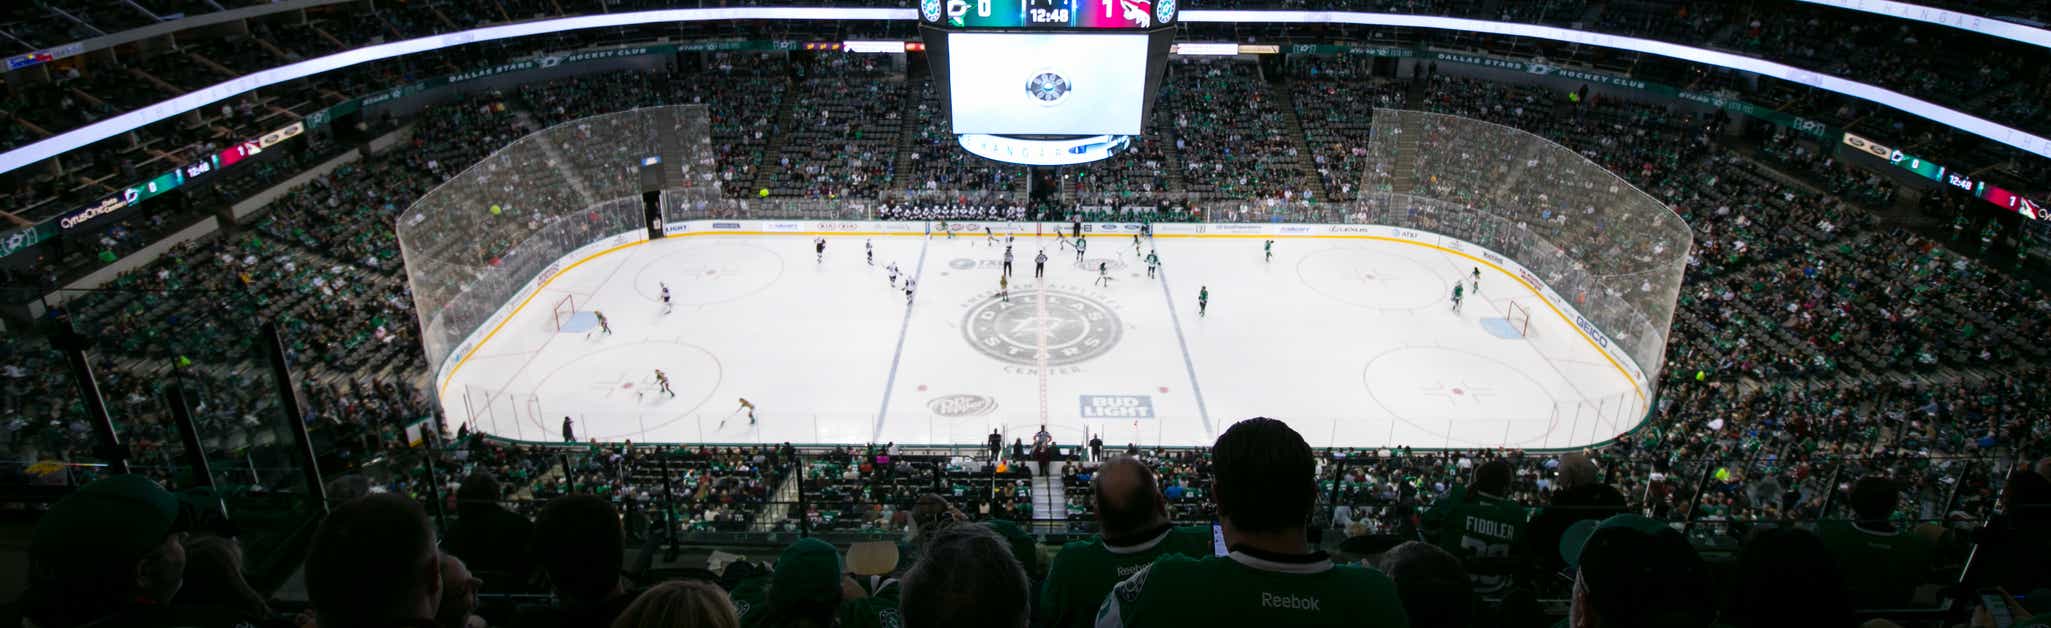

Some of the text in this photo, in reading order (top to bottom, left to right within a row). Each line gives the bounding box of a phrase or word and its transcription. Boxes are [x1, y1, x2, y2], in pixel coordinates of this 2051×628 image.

[977, 0, 991, 17] 0
[1030, 9, 1069, 22] 12:48
[1102, 0, 1112, 18] 1
[569, 48, 647, 62] HOCKEY CLUB
[1438, 53, 1522, 71] DALLAS STARS
[449, 61, 533, 83] DALLAS STARS
[1559, 69, 1646, 89] HOCKEY CLUB
[1948, 174, 1972, 191] 12:48
[61, 206, 105, 229] CyrusOne
[980, 296, 1103, 321] DALLAS
[1577, 315, 1608, 348] GEICO
[984, 335, 1100, 361] STARS
[1092, 396, 1139, 407] BUD
[1084, 406, 1149, 417] LIGHT
[1466, 515, 1514, 541] FIDDLER
[1262, 592, 1320, 611] Reebok
